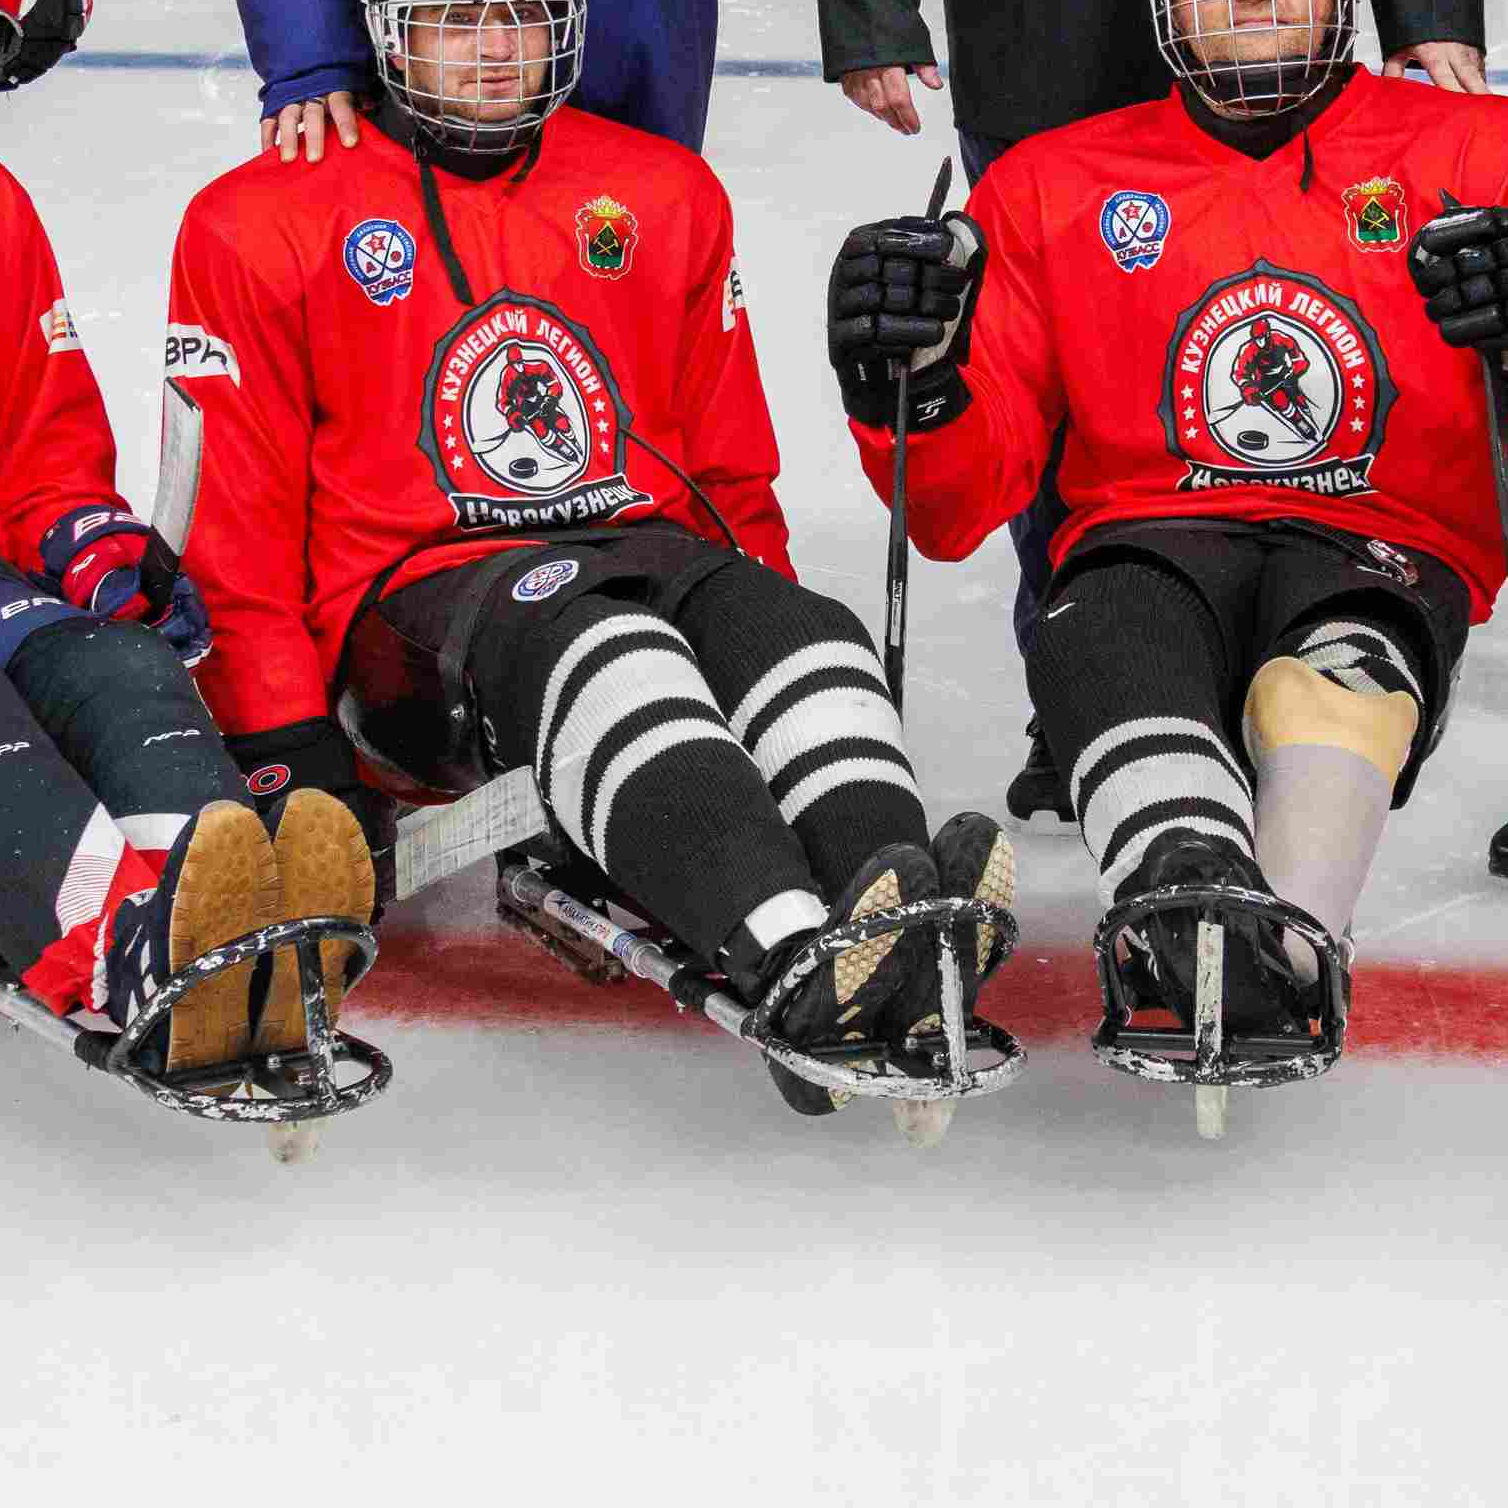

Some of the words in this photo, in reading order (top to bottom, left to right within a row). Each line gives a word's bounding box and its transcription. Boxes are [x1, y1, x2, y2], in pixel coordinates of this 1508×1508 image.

[440, 307, 530, 402] КУЗНЕЦКИЙ
[534, 319, 602, 396] ЛЕГИОН
[1181, 282, 1285, 374] КУЗНЕЦКИЙ
[1288, 292, 1365, 371] ЛЕГИОН
